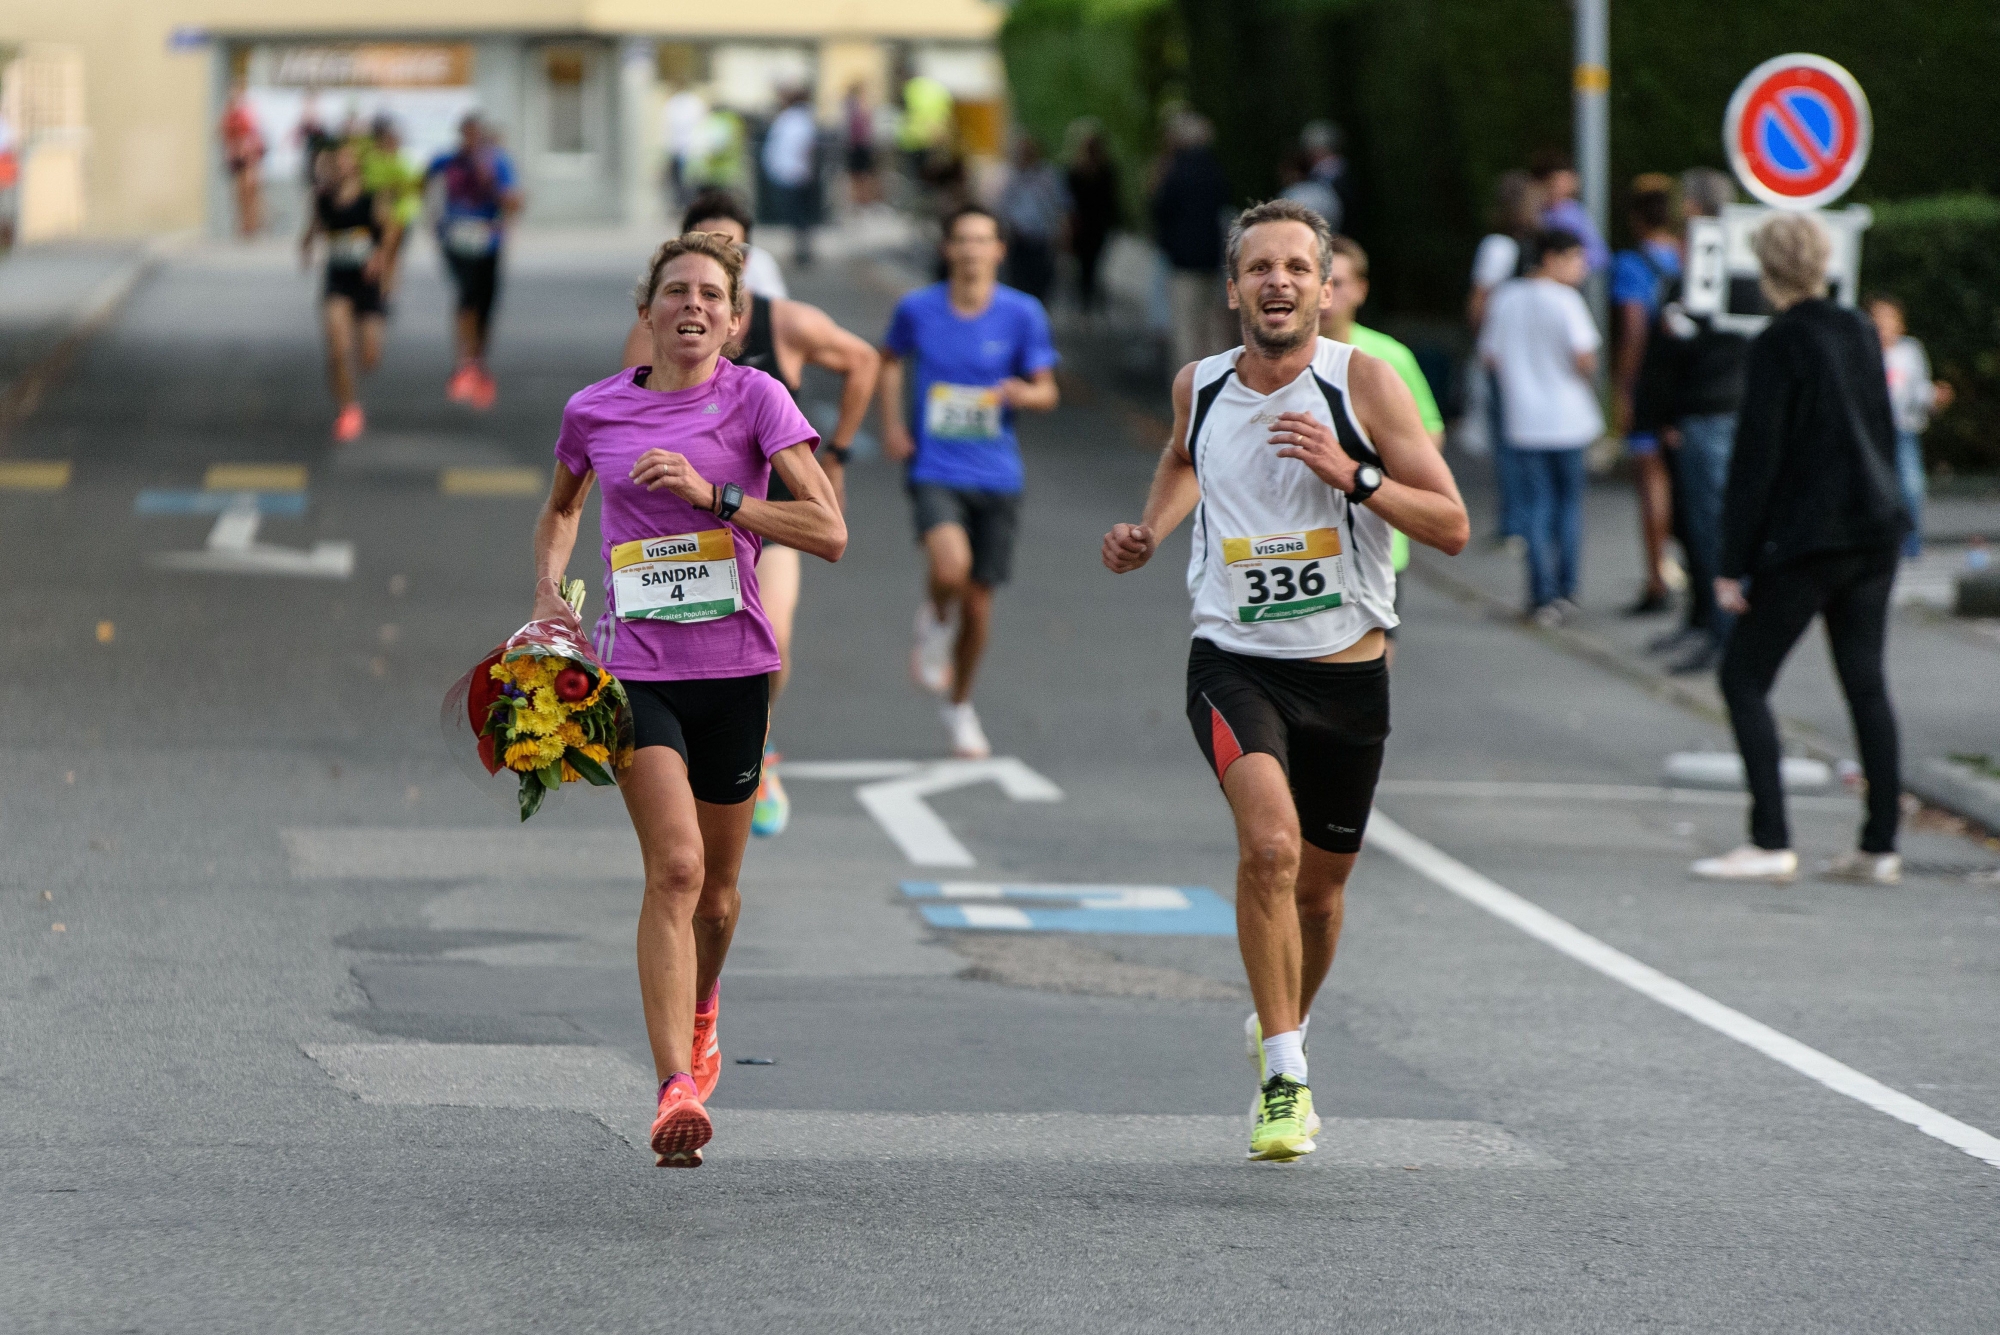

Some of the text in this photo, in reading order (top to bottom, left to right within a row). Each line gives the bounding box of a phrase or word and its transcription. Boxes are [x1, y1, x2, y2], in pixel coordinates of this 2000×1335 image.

[641, 564, 710, 587] SANDRA
[1244, 560, 1326, 605] 336
[670, 584, 685, 602] 4
[683, 609, 718, 618] Populaires
